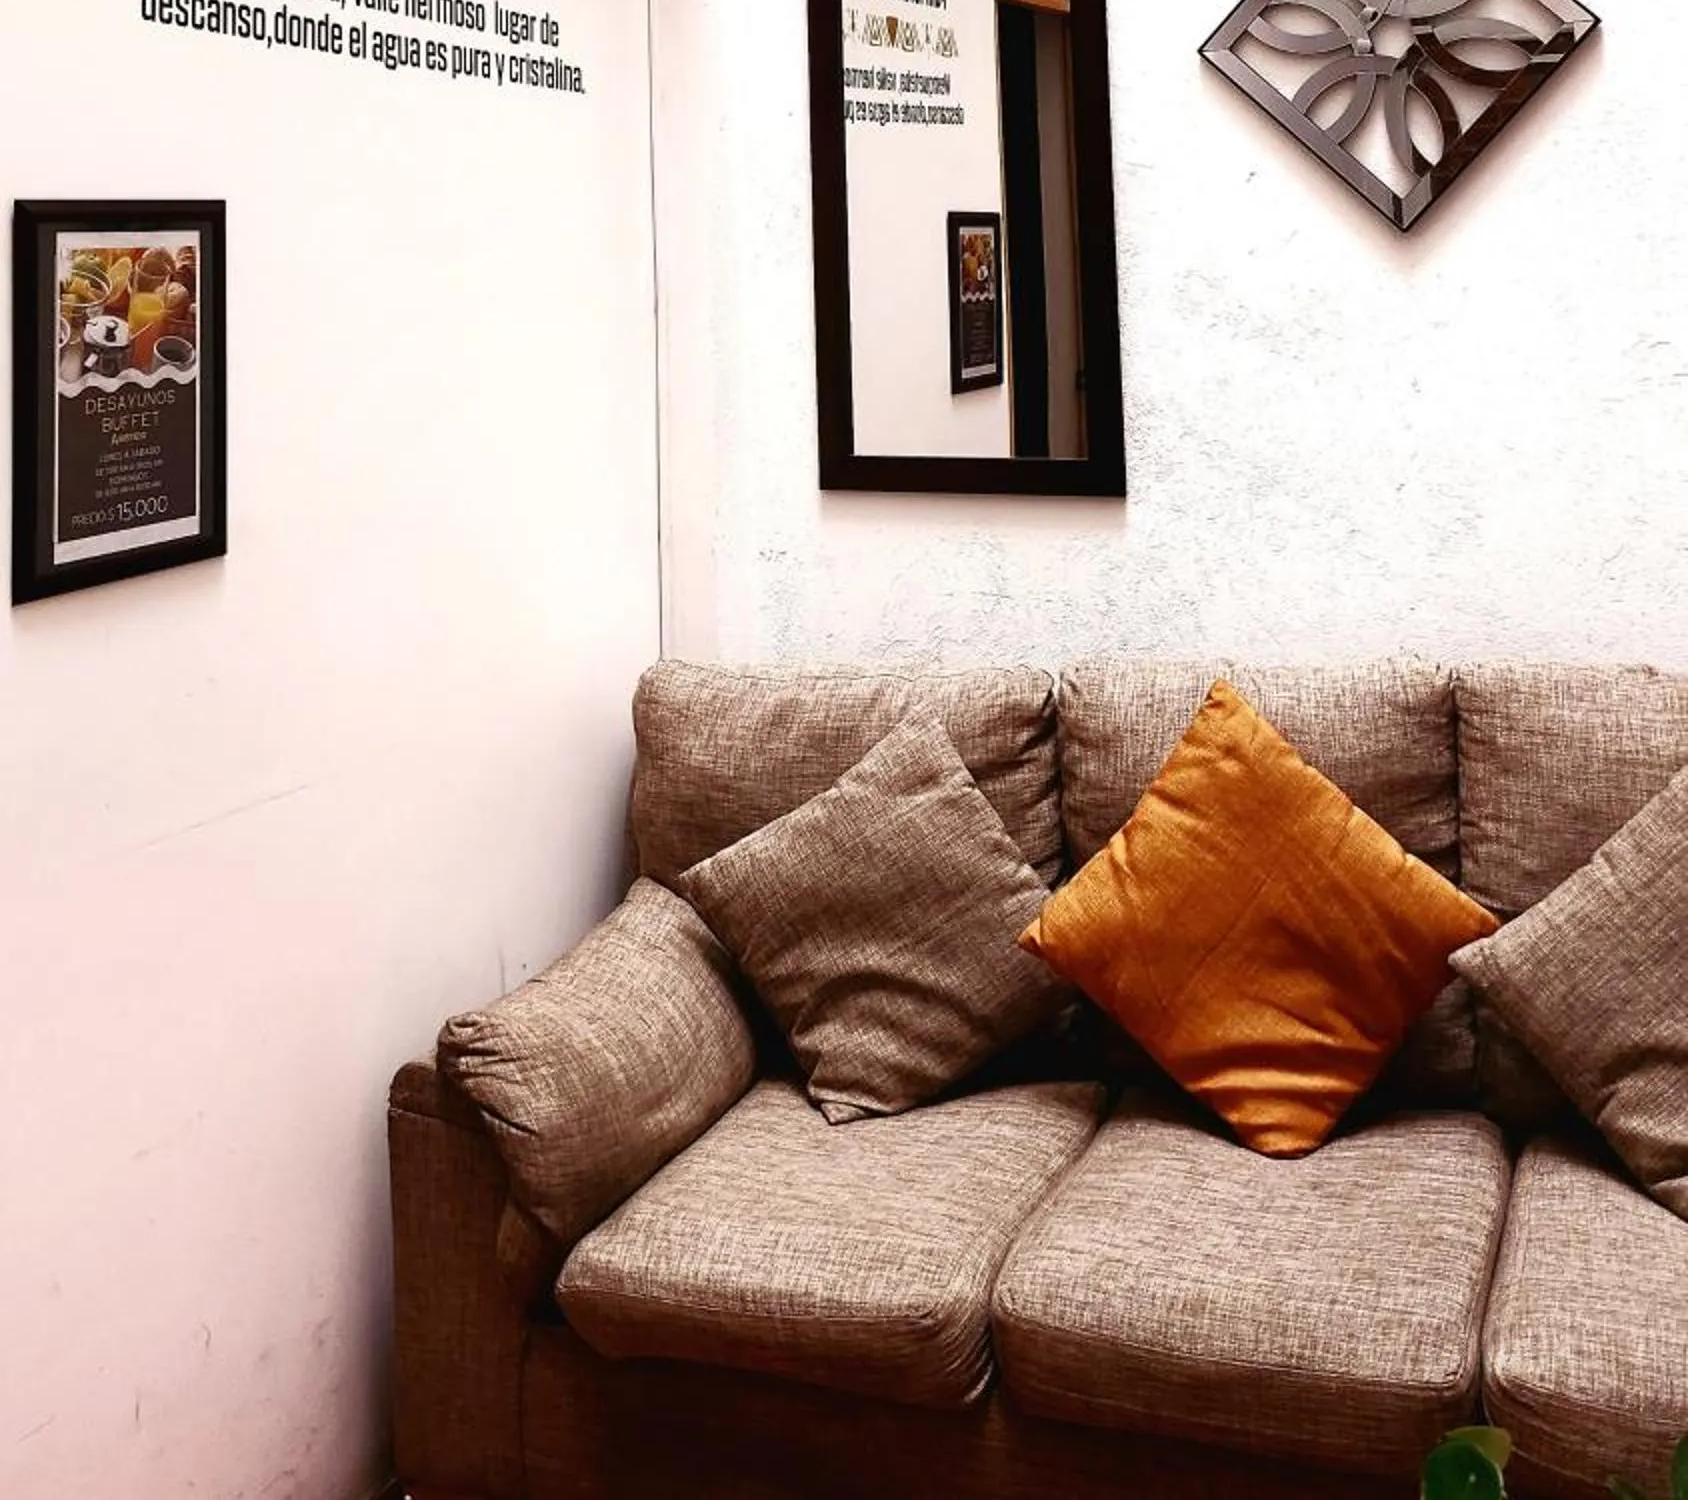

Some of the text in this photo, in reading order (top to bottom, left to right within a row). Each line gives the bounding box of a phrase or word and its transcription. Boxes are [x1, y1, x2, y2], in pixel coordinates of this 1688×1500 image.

[494, 0, 537, 45] lugar
[539, 11, 560, 47] de
[349, 21, 368, 59] el
[372, 28, 422, 71] agua
[425, 39, 448, 72] es
[451, 43, 492, 79] pura
[494, 51, 506, 87] y
[509, 52, 587, 95] cristalina.
[85, 389, 176, 416] DESAYUNOS
[101, 411, 160, 434] BUFFET
